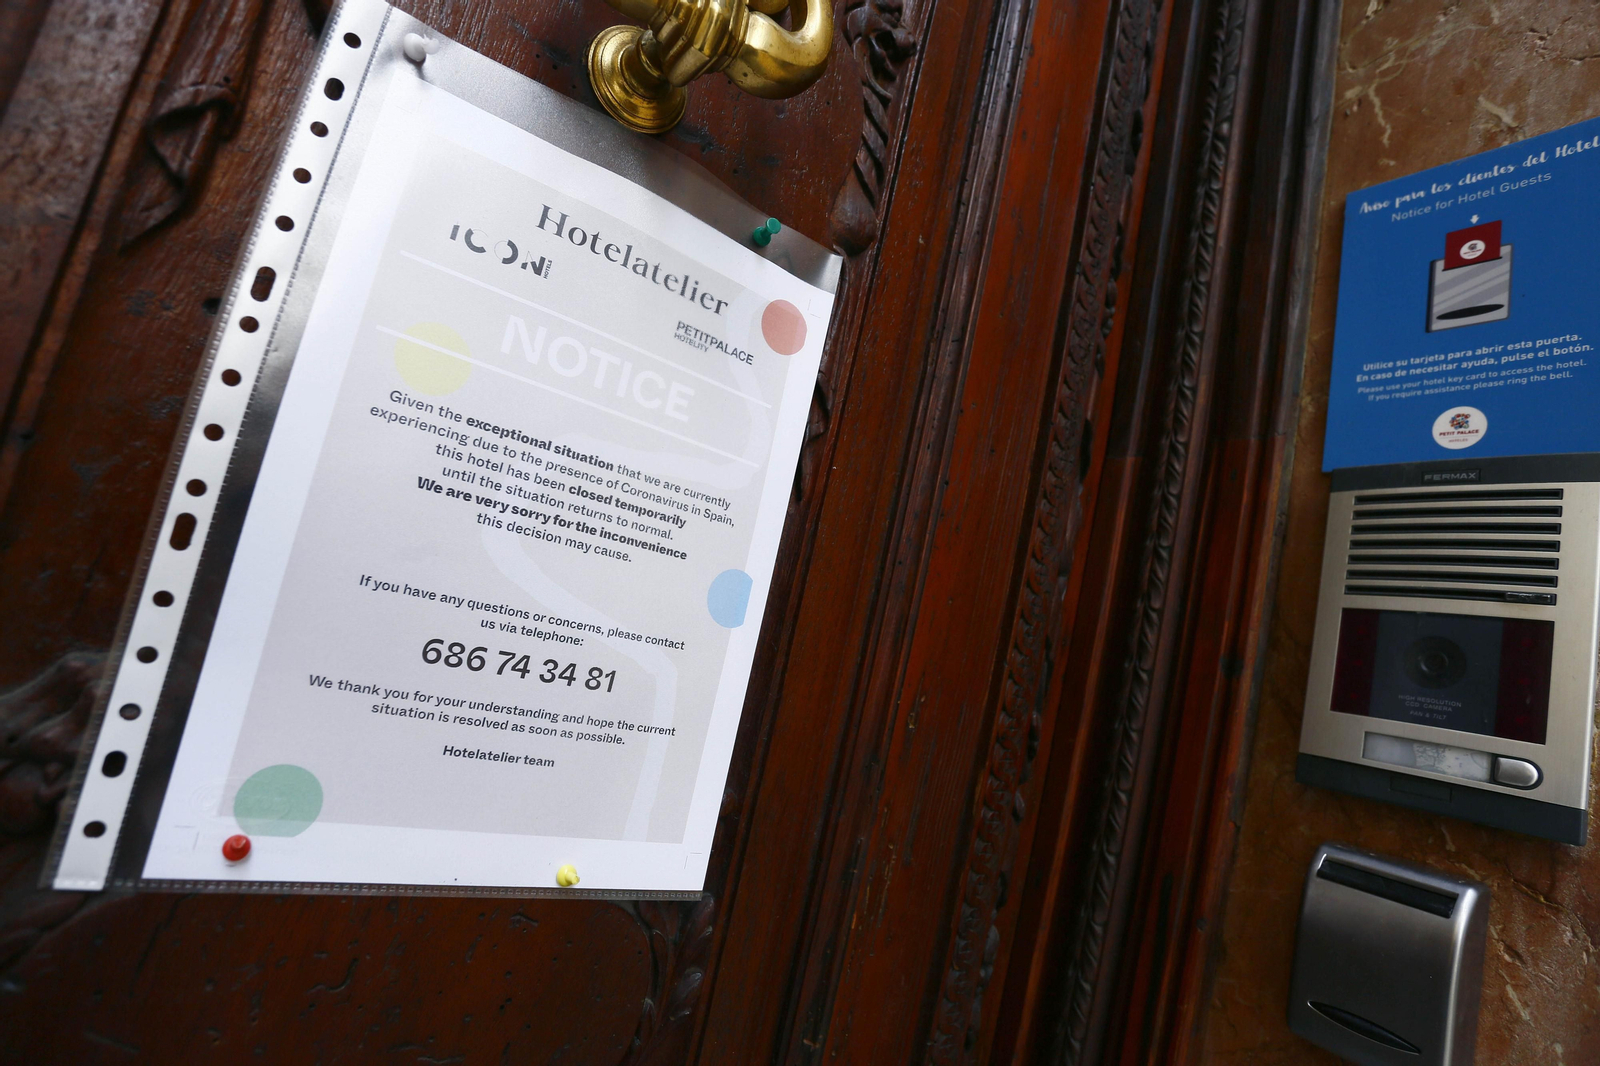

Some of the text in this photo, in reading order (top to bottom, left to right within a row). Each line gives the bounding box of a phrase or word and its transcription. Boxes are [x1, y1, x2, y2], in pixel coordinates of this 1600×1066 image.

[1359, 135, 1600, 214] Aviso para los clientes del Hotel
[1392, 173, 1551, 222] Notice for Hotel Guests
[449, 222, 546, 276] ICON
[535, 204, 729, 317] Hotelatelier
[543, 260, 552, 279] HOTELS
[674, 332, 709, 353] HOTELITY
[676, 320, 754, 365] PETITPALACE
[1356, 343, 1594, 382] En caso de necesitar ayuda, pulse el botón.
[1363, 361, 1394, 371] Utilice
[1410, 352, 1445, 365] tarjeta
[1448, 349, 1472, 361] para
[1475, 345, 1503, 356] abrir
[1507, 341, 1533, 351] esta
[1536, 334, 1582, 349] puerta.
[500, 314, 695, 423] NOTICE
[1357, 359, 1587, 394] Please use your hotel key card to access the hotel.
[1376, 394, 1390, 402] you
[1392, 389, 1422, 399] require
[1424, 384, 1471, 395] assistance
[1473, 381, 1505, 391] please
[1507, 377, 1527, 387] ring
[1530, 374, 1547, 382] the
[1550, 371, 1573, 380] bell.
[370, 406, 735, 527] experiencing due to the presence of Coronavirus in Spain,
[389, 389, 731, 511] Given the exceptional situation that we are currently
[435, 443, 687, 529] this hotel has been closed temporarily
[1424, 471, 1476, 481] FERMAX
[416, 476, 687, 560] We are very sorry for the inconvenience
[442, 466, 673, 540] until the situation returns to normal.
[476, 512, 632, 563] this decision may cause.
[359, 574, 685, 650] If you have any questions or concerns, please contact
[480, 618, 584, 647] us via telephone:
[422, 638, 616, 693] 686 74 34 81
[309, 674, 676, 736] We thank you for your understanding and hope the current
[371, 701, 625, 746] situation is resolved as soon as possible.
[1417, 697, 1462, 707] RESOLUTION
[1423, 703, 1453, 712] CAMERA
[442, 745, 555, 768] Hotelatelier team
